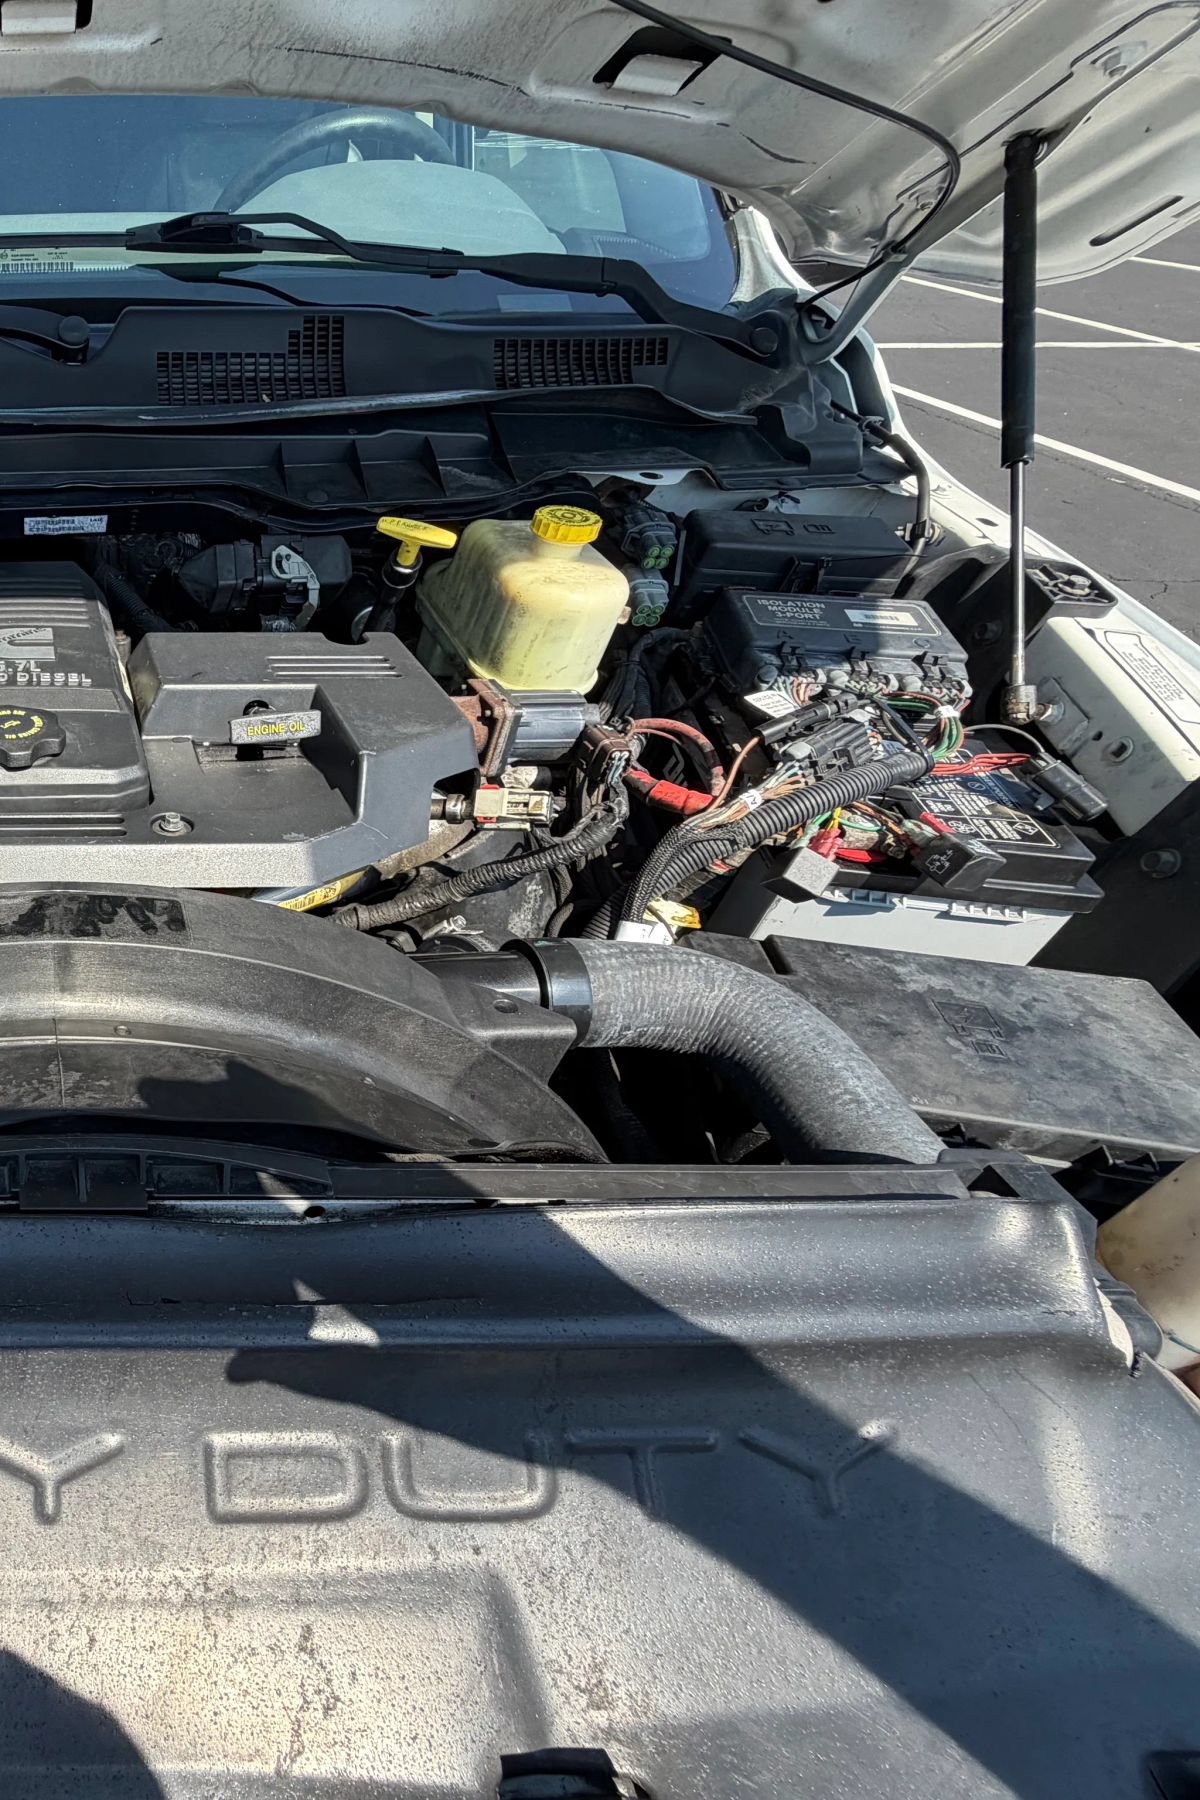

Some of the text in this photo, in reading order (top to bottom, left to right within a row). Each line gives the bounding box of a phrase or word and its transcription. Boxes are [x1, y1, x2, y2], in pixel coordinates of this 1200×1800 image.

[756, 599, 826, 609] ISOLATION
[767, 605, 824, 615] MODULE
[774, 611, 821, 620] 3-PORT
[16, 672, 93, 686] DIESEL
[246, 720, 305, 737] ENGINE OIL
[202, 1416, 894, 1526] DUTY
